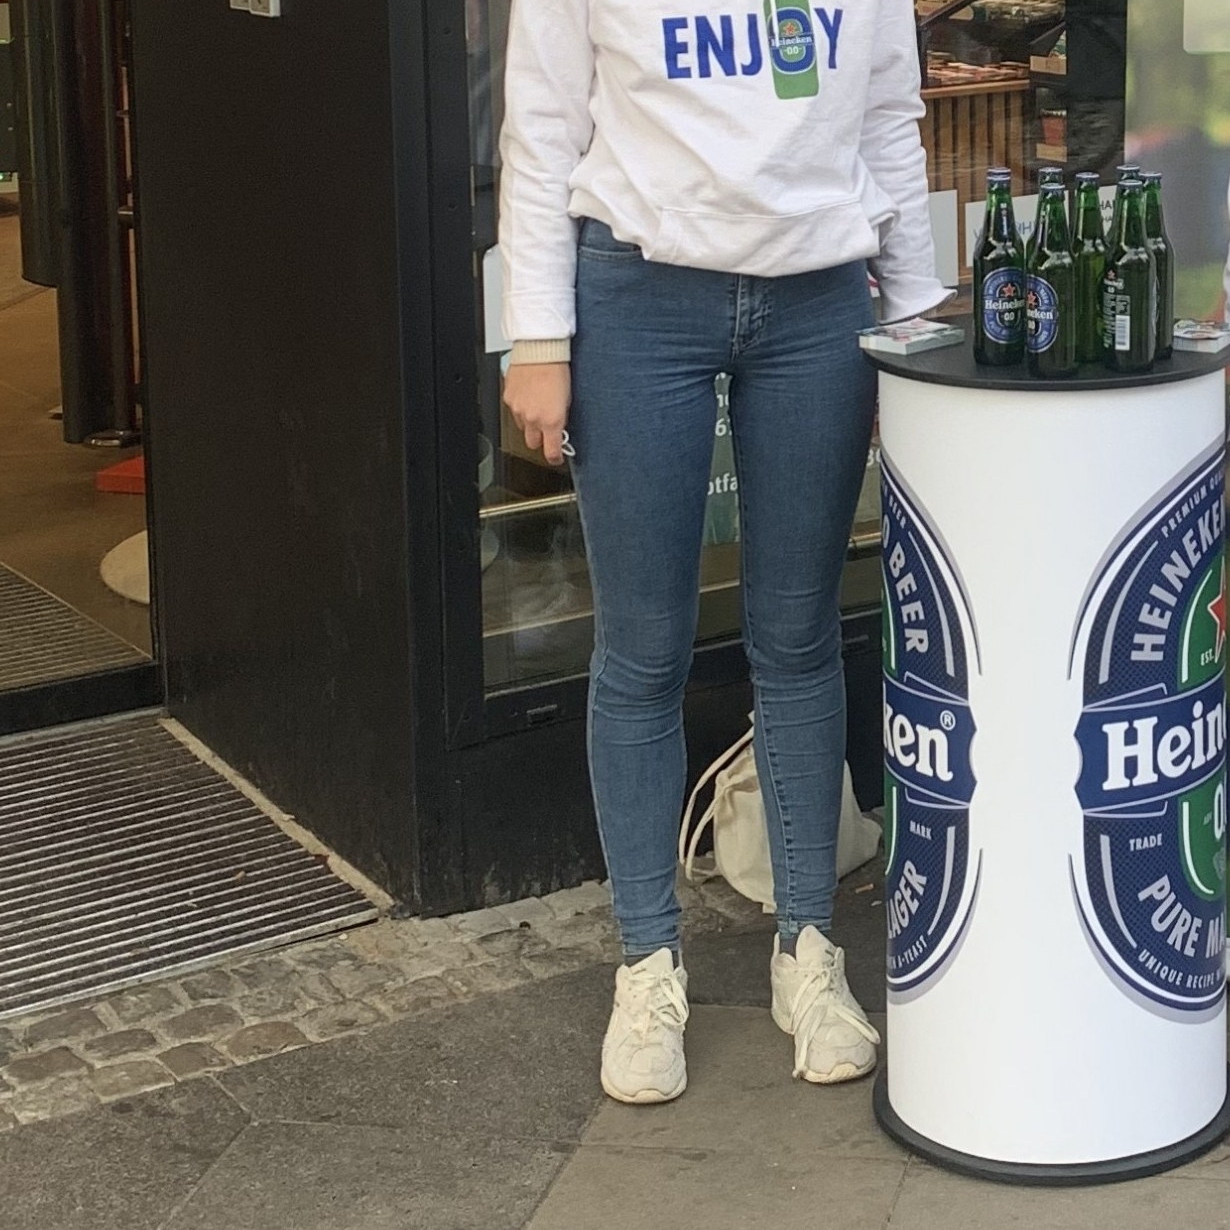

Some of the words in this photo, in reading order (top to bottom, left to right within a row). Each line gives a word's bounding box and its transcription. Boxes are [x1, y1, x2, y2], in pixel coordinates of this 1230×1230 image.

[662, 7, 844, 79] ENJOY
[1160, 484, 1208, 539] PREMIUM
[889, 541, 929, 653] BEER
[1200, 648, 1215, 667] EST.
[1101, 699, 1227, 791] Hein
[909, 820, 932, 841] MARK
[1129, 833, 1163, 852] TRADE
[886, 859, 928, 940] LAGER
[1137, 873, 1203, 958] PURE
[1138, 948, 1184, 987] UNIQUE
[1186, 971, 1215, 990] RECIPE
